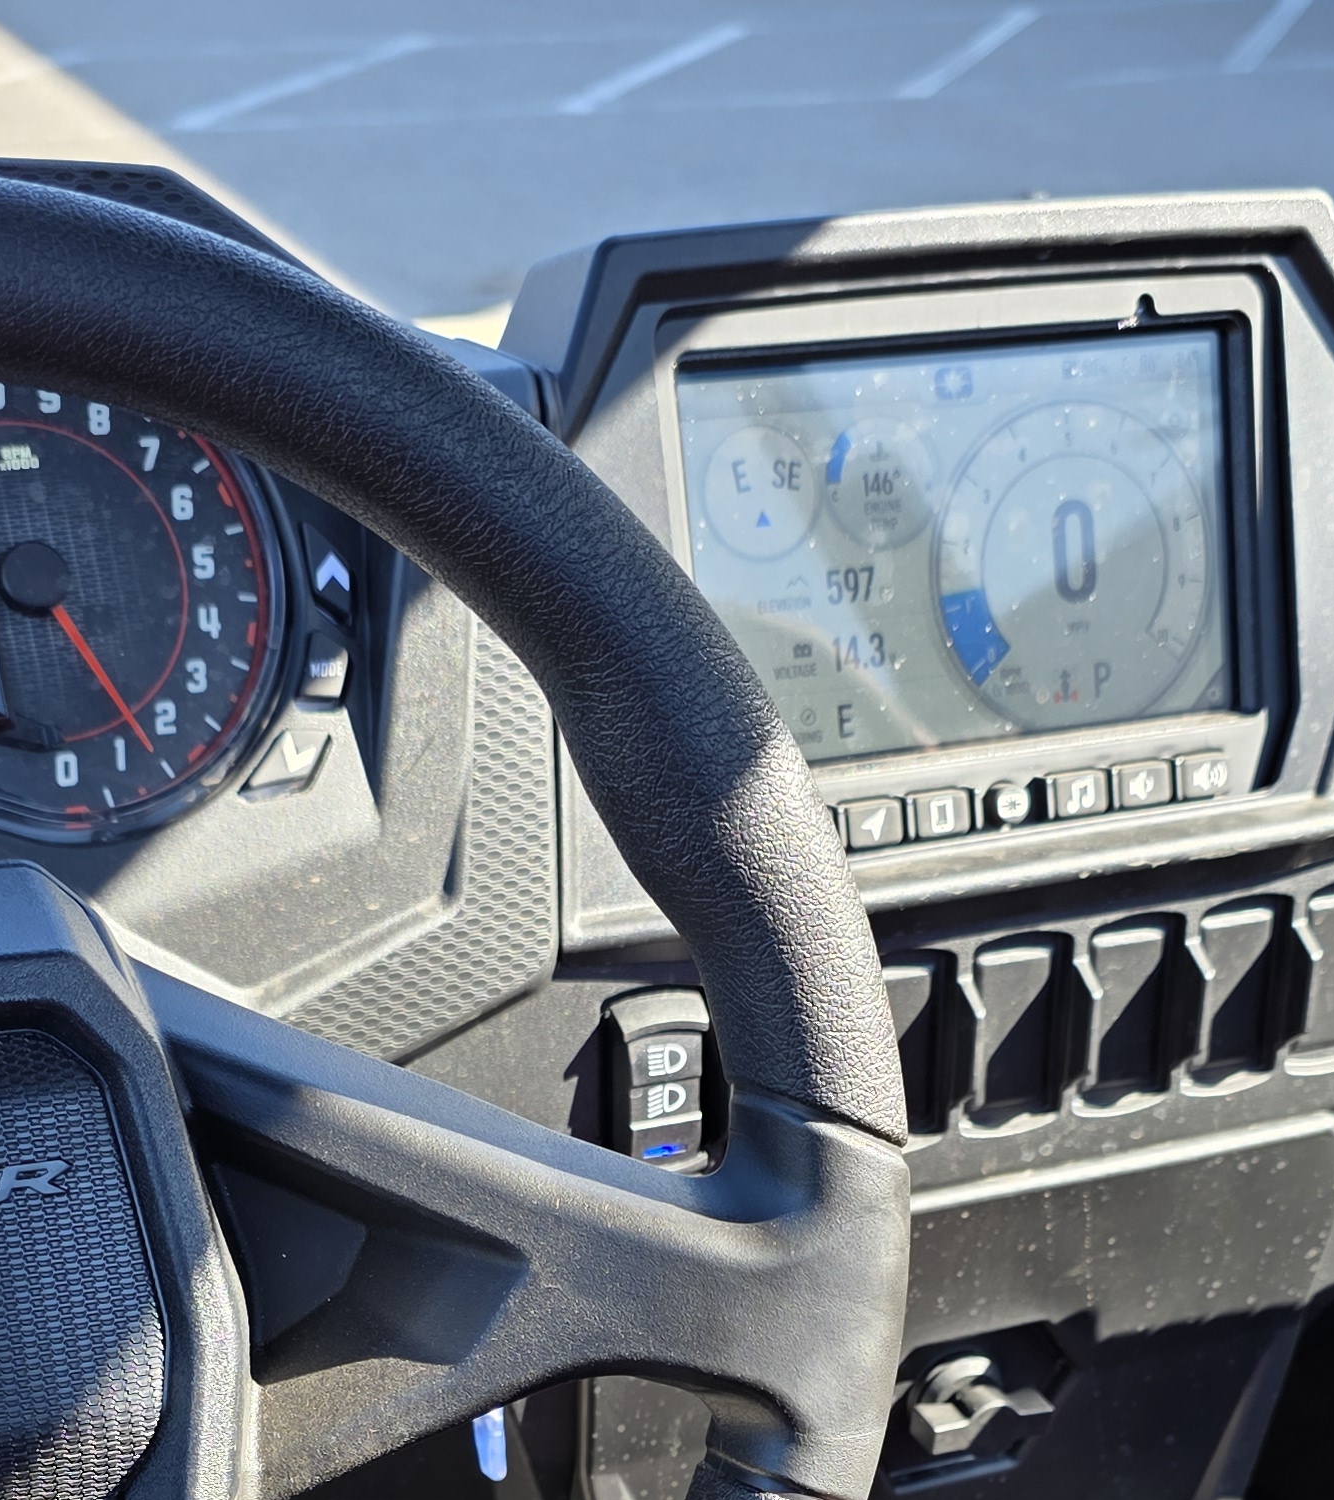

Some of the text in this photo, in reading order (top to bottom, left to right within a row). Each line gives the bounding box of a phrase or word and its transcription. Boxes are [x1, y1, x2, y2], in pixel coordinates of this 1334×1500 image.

[87, 401, 111, 436] 8
[0, 444, 32, 460] RPM
[138, 435, 160, 472] 7
[731, 459, 803, 494] E SE
[170, 483, 194, 521] 6
[191, 543, 216, 580] 5
[1051, 499, 1097, 605] 0
[826, 566, 875, 606] 597
[197, 604, 222, 640] 4
[309, 659, 344, 679] MODE
[833, 632, 885, 673] 14.3
[185, 656, 208, 694] 3
[1093, 661, 1112, 699] P
[154, 699, 177, 736] 2
[837, 703, 855, 740] E
[54, 751, 79, 788] 0
[113, 736, 127, 772] 1
